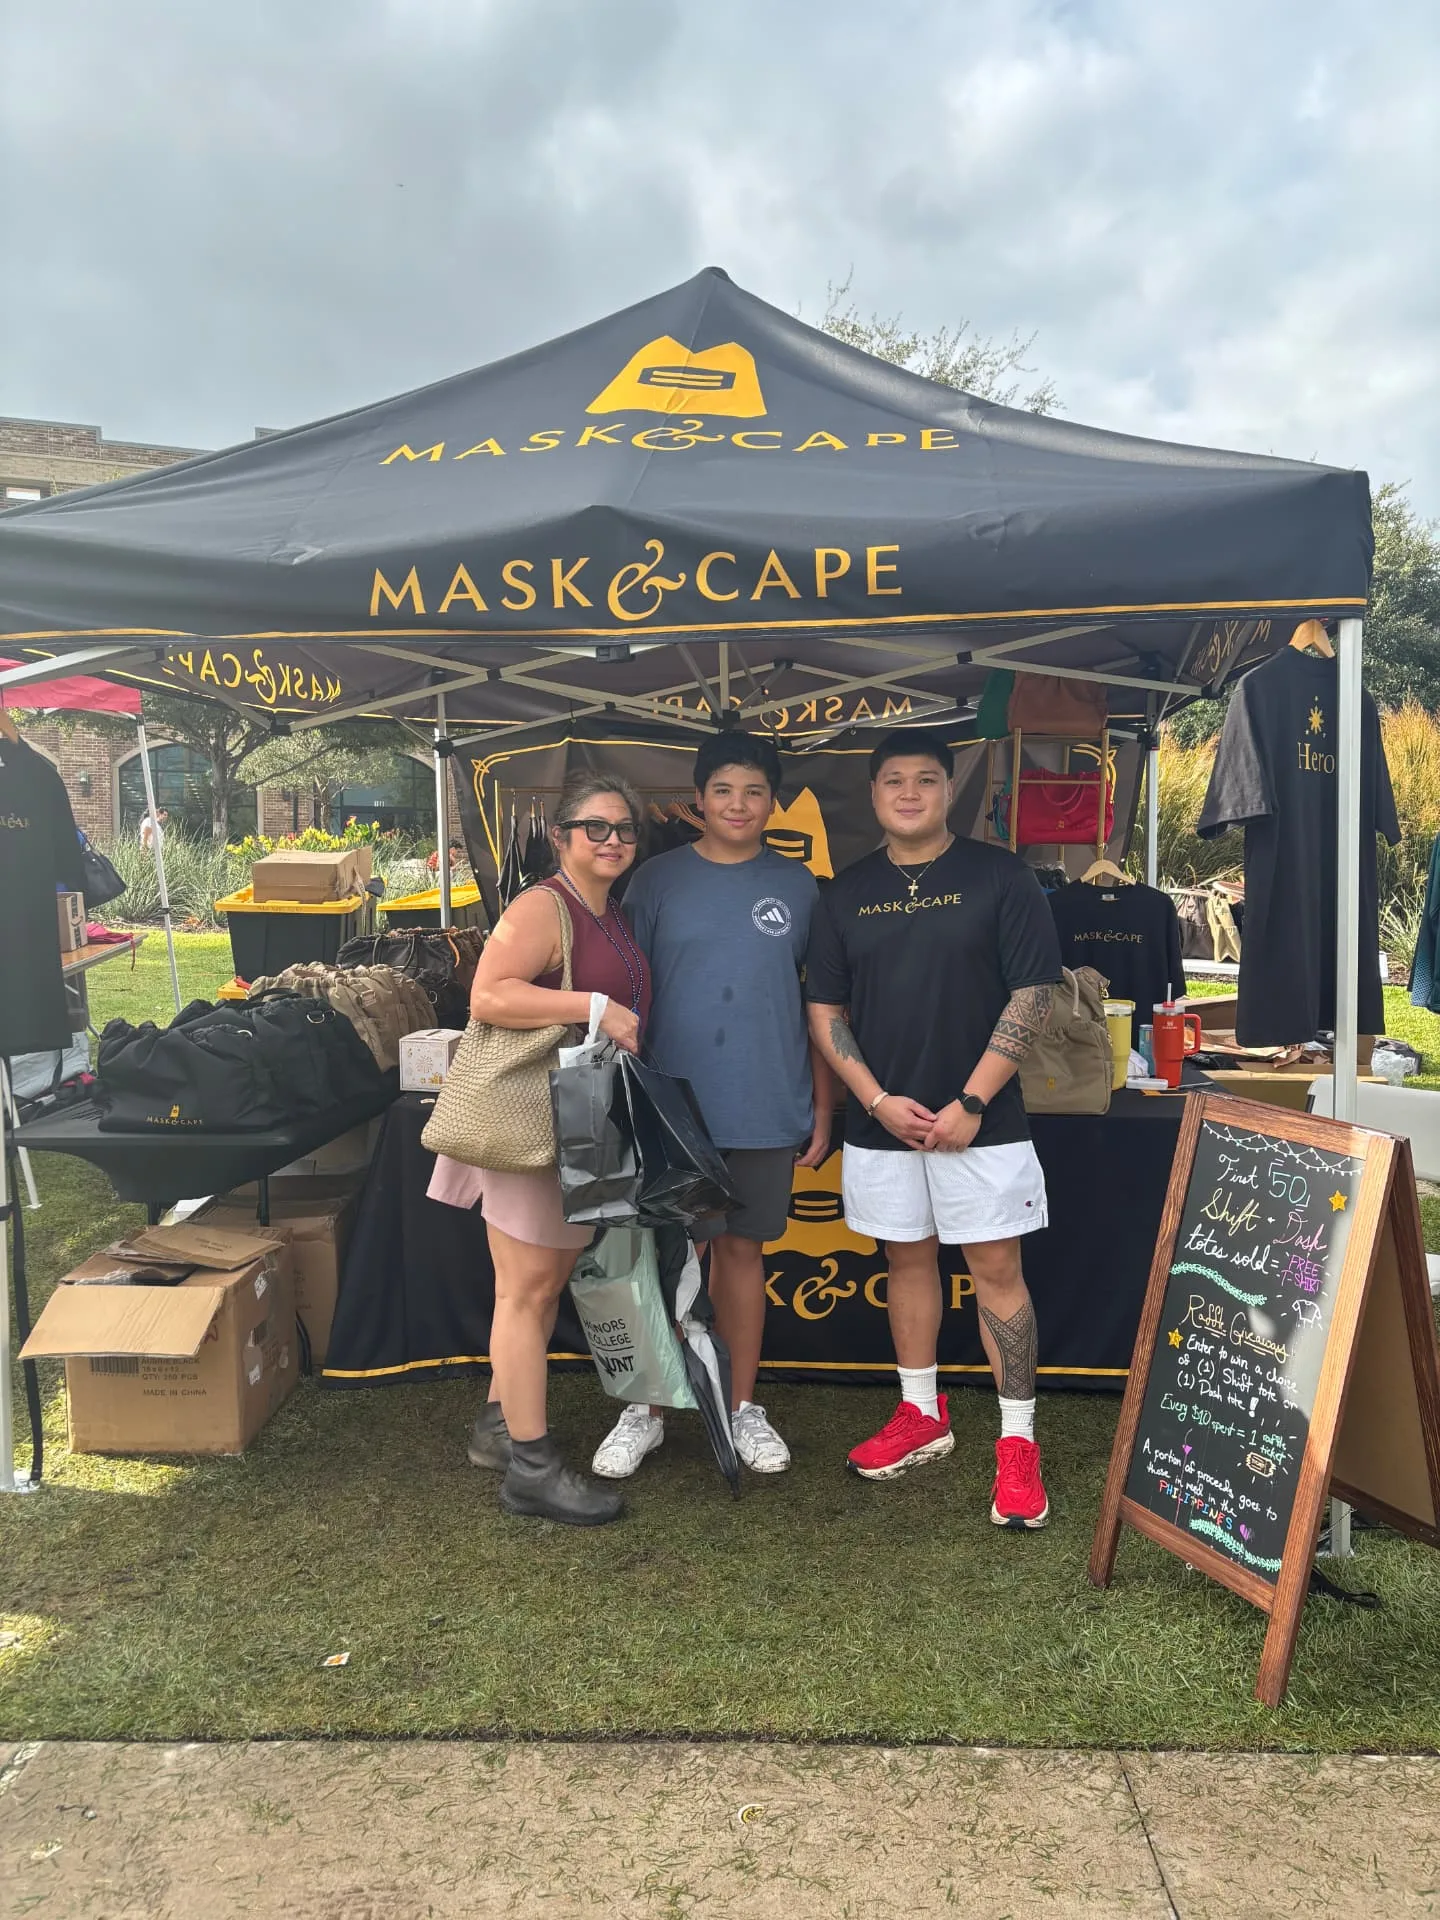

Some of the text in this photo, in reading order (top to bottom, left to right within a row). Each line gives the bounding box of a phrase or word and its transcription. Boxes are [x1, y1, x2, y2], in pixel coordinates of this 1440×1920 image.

[1297, 741, 1335, 774] Hero
[1217, 1153, 1308, 1204] First 50
[1200, 1188, 1261, 1236] Shift
[1272, 1211, 1328, 1251] Dash
[1185, 1223, 1229, 1259] totes
[1230, 1244, 1271, 1275] sold
[1288, 1254, 1324, 1277] FREE
[1178, 1353, 1190, 1366] of
[1223, 1367, 1254, 1392] Shift
[1258, 1382, 1277, 1402] tote
[1187, 1334, 1215, 1355] Enter
[1219, 1346, 1228, 1360] to
[1230, 1355, 1248, 1370] win
[1255, 1365, 1263, 1375] a
[1160, 1393, 1188, 1422] Every
[1211, 1420, 1236, 1437] spent
[1198, 1379, 1222, 1402] Dash
[1143, 1437, 1151, 1454] A
[1154, 1449, 1181, 1467] portion
[1184, 1460, 1196, 1474] of
[1239, 1495, 1261, 1512] goes
[1266, 1506, 1277, 1521] to
